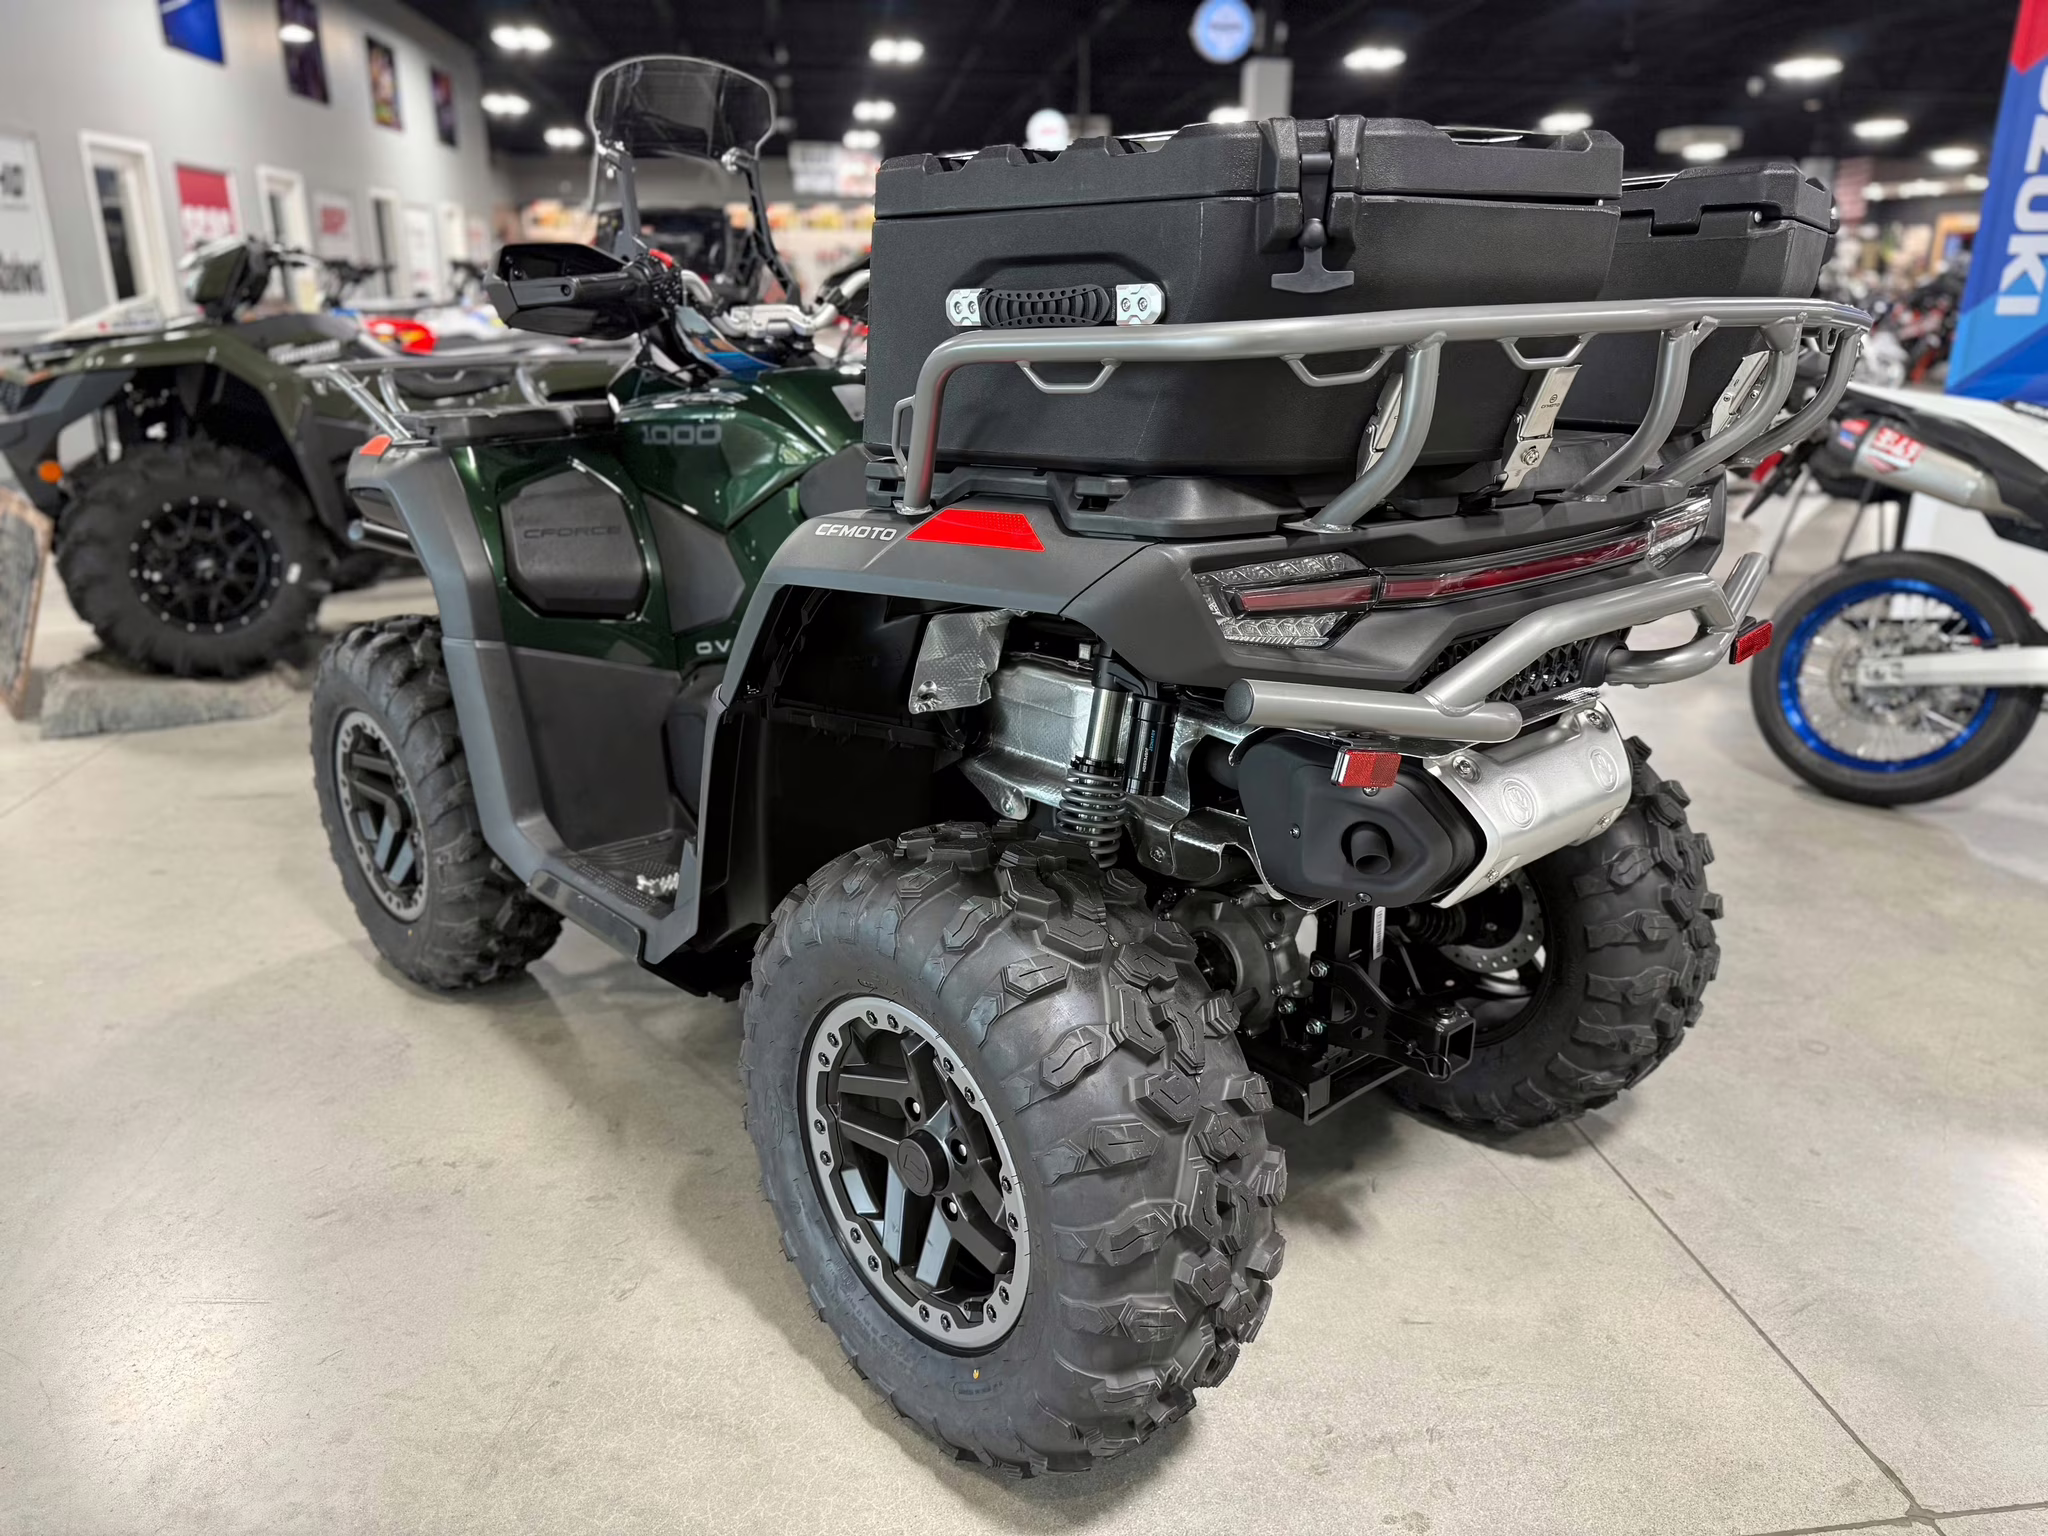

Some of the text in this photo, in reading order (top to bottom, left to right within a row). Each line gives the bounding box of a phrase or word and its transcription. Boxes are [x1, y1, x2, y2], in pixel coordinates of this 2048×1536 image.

[641, 424, 722, 445] 1000
[524, 526, 621, 539] CFORCE
[815, 523, 897, 541] CFMOTO
